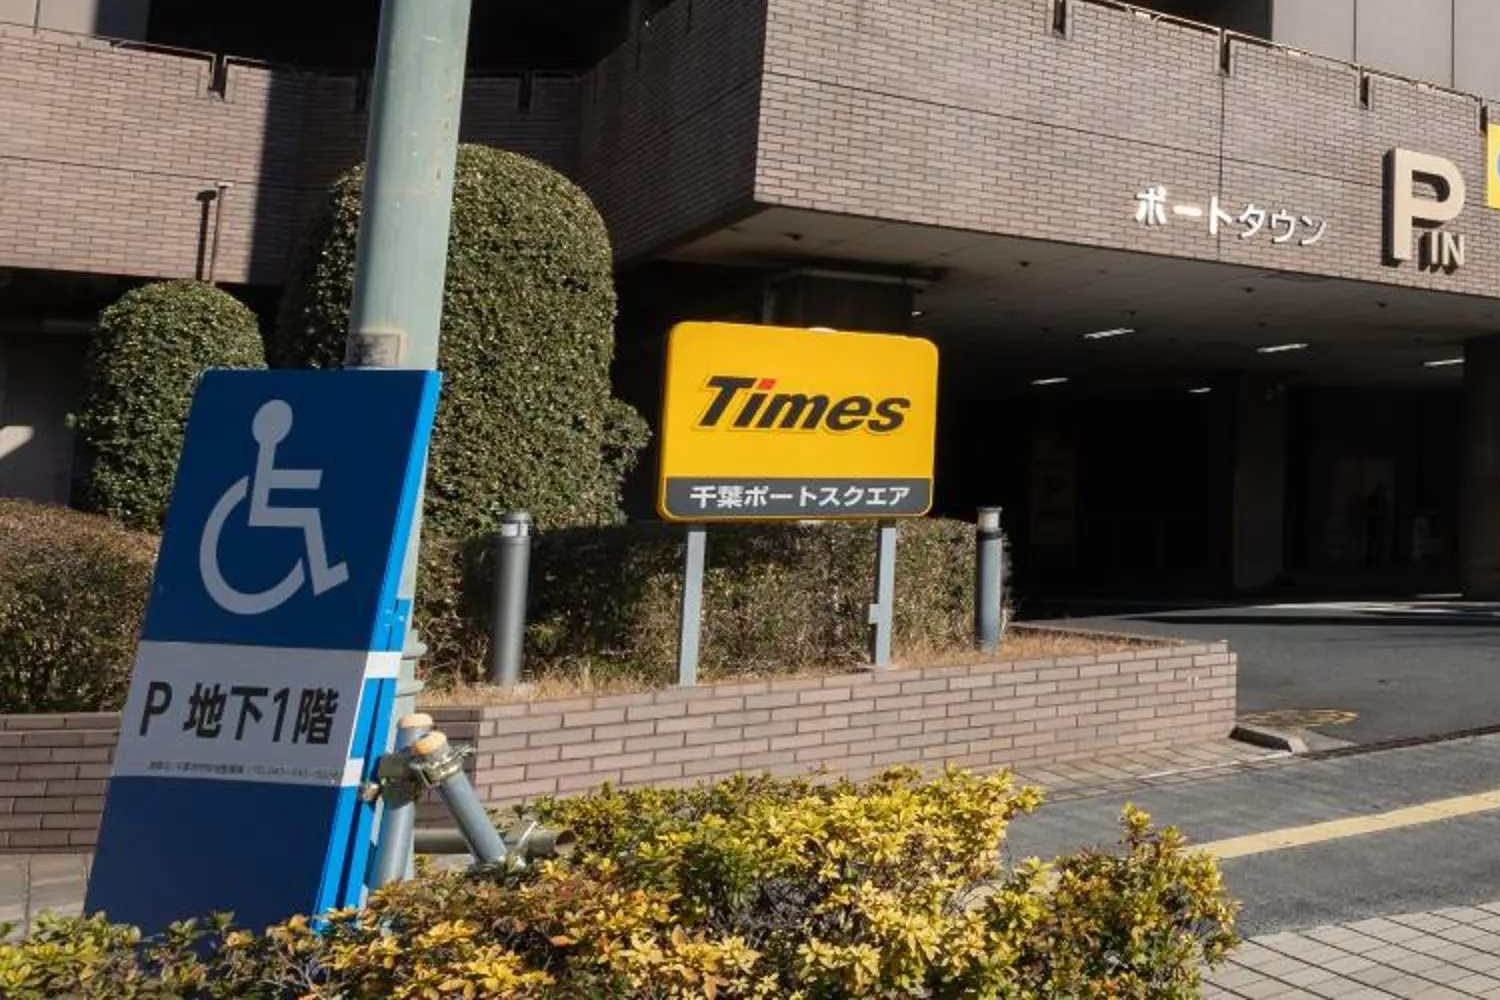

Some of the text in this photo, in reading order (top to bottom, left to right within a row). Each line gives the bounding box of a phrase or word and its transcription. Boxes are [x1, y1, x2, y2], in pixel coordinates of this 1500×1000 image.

[1135, 185, 1327, 246] ポートタウン
[1391, 147, 1466, 261] P
[1430, 230, 1466, 267] IN
[698, 374, 912, 433] Times
[688, 484, 911, 510] 千葉ポートスクエア
[139, 681, 341, 745] P 地下1階
